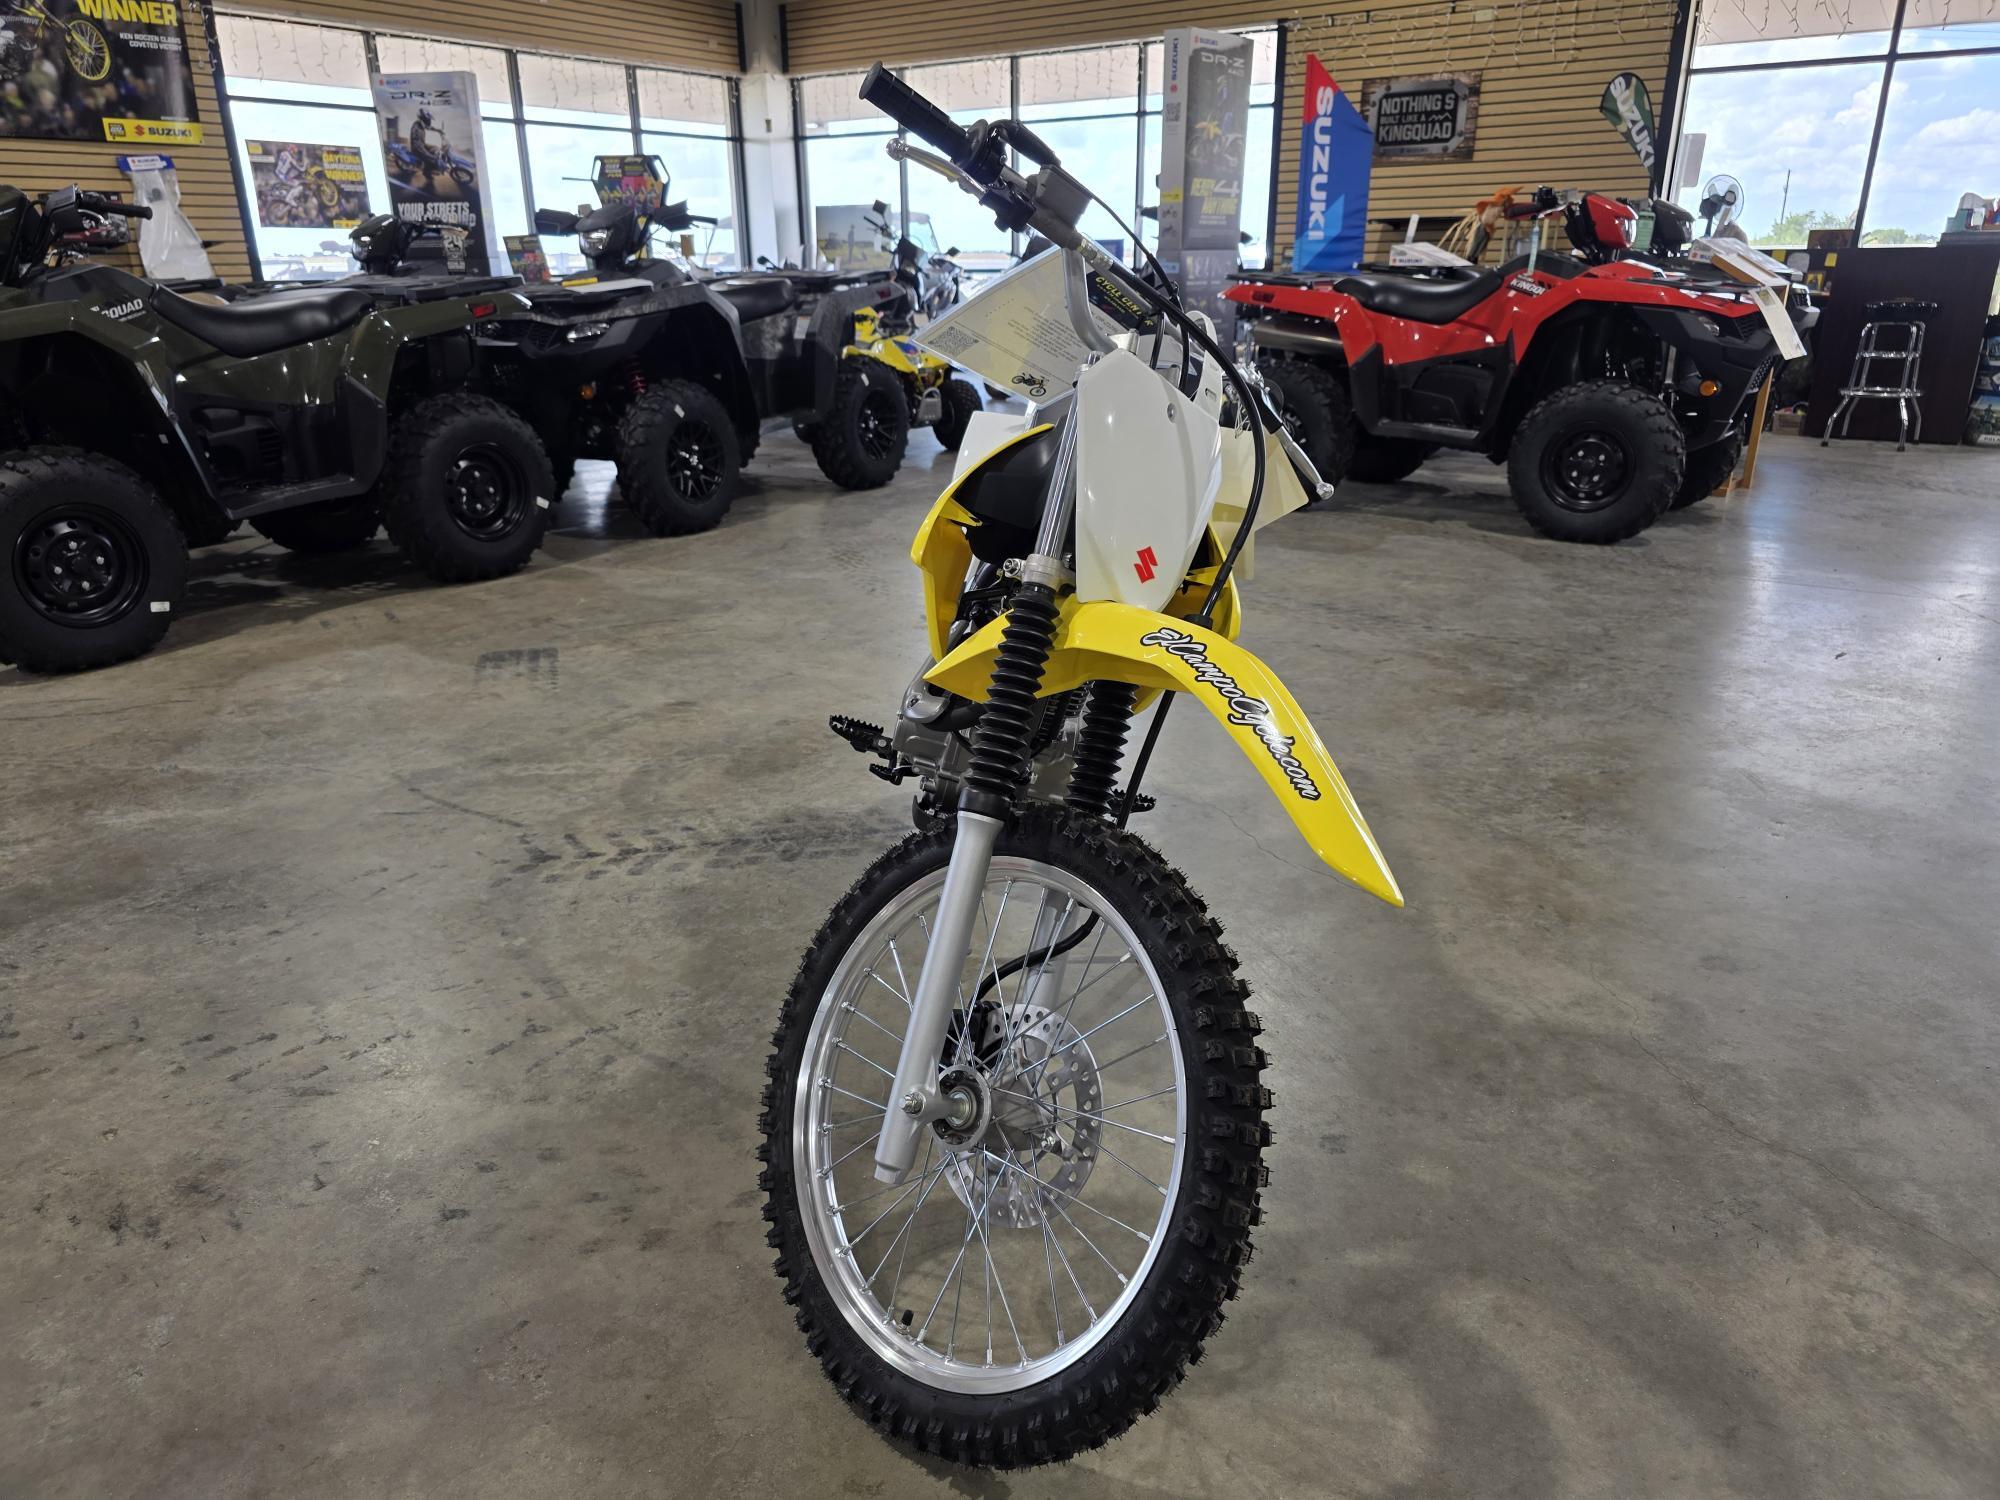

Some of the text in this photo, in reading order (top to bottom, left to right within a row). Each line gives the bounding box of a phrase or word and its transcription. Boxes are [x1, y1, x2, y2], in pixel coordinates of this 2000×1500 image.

[76, 0, 178, 26] WINNER
[1170, 37, 1180, 81] SUZUKI
[1200, 51, 1245, 68] DR-Z
[1381, 94, 1443, 115] NOTHING
[1380, 114, 1427, 125] BUILT LIKE A
[1609, 76, 1656, 168] SUZUKI
[148, 126, 193, 137] SUZUKI
[1379, 121, 1453, 142] KINGQUAD
[1308, 86, 1334, 241] SUZUKI
[398, 202, 470, 215] YOUR STREETS
[1096, 277, 1121, 298] CYCLE
